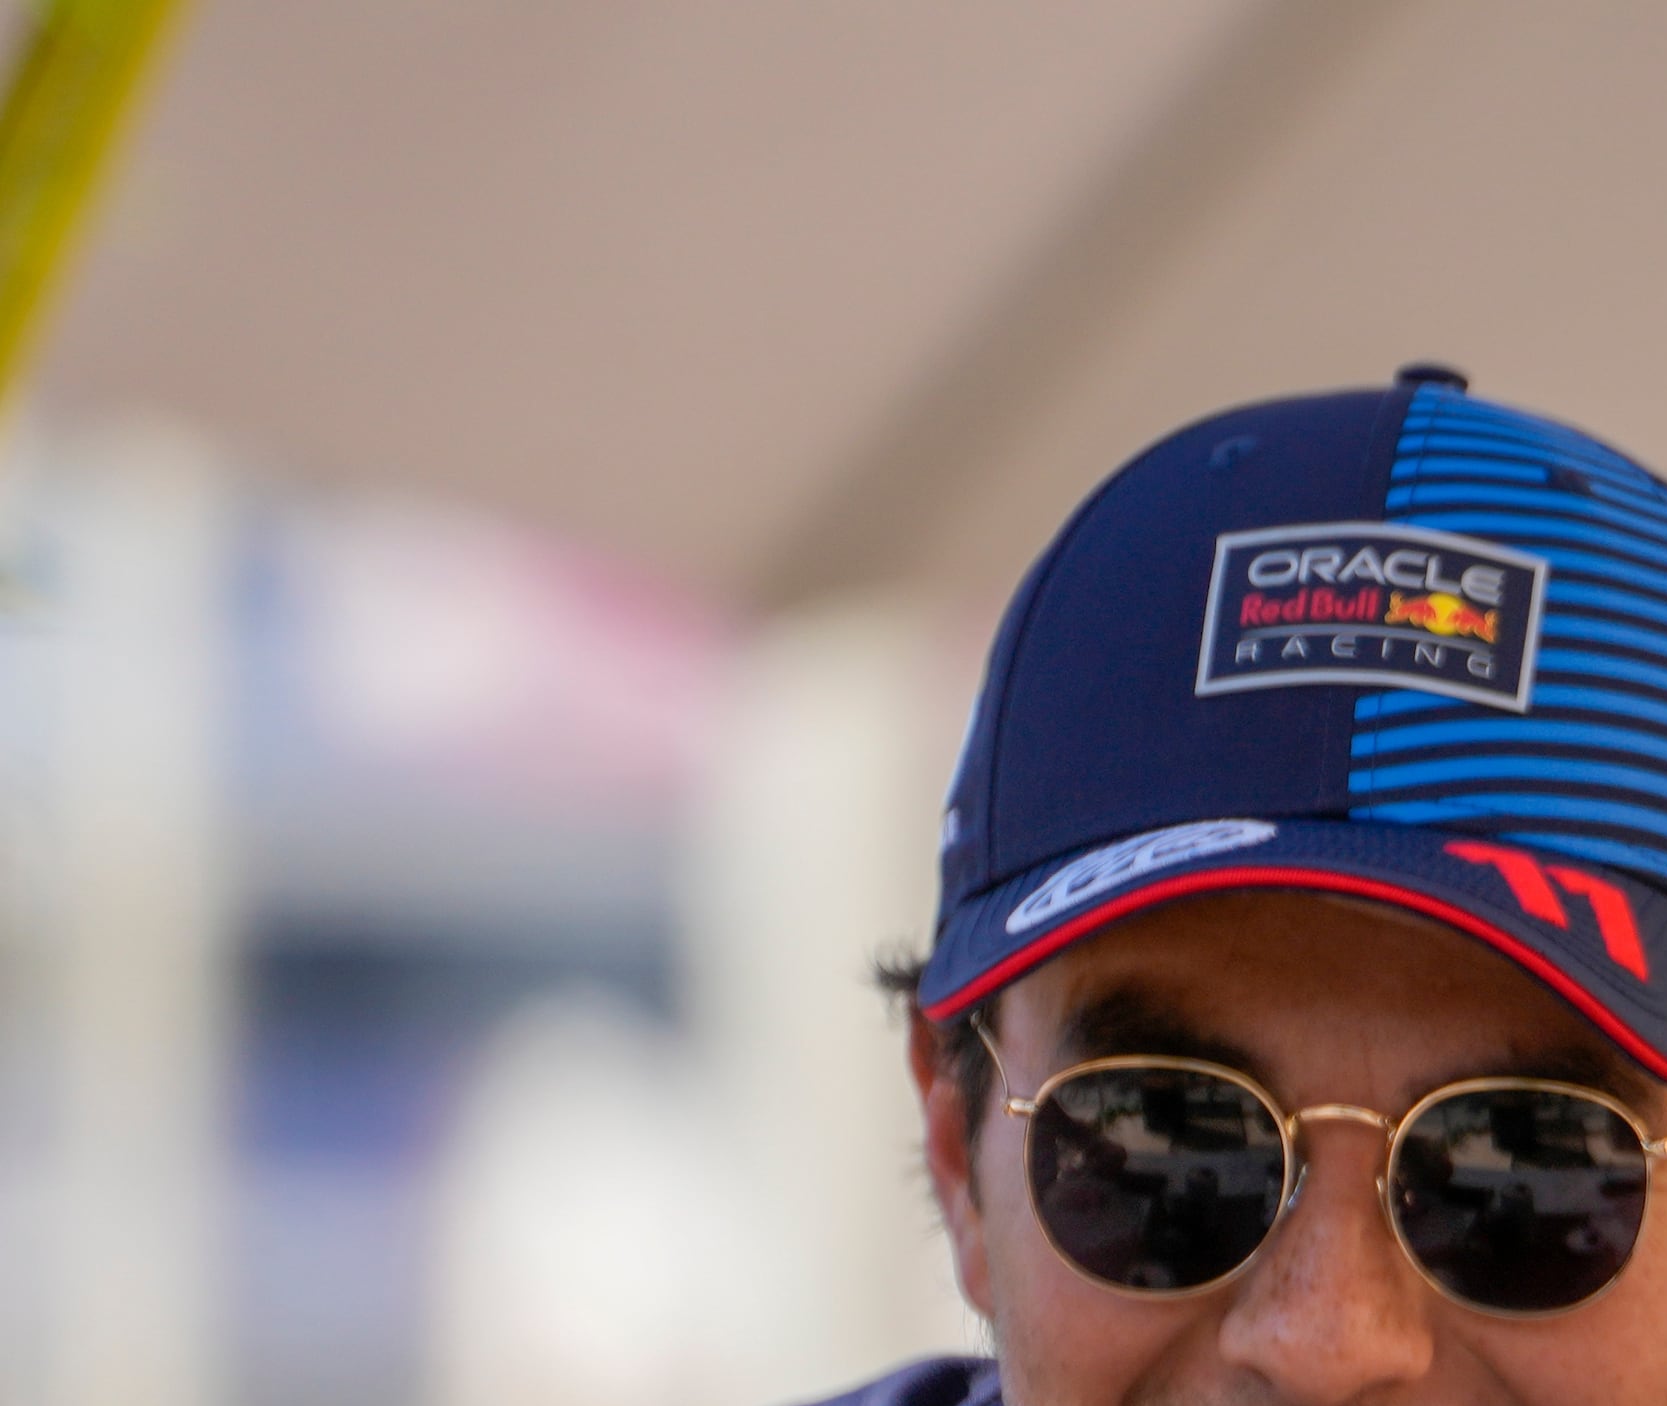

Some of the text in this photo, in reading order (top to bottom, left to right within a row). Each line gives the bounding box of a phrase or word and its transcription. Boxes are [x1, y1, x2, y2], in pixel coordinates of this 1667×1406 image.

[1248, 546, 1504, 605] ORACLE
[1239, 587, 1380, 628] Red Bull
[1235, 634, 1496, 679] RACING
